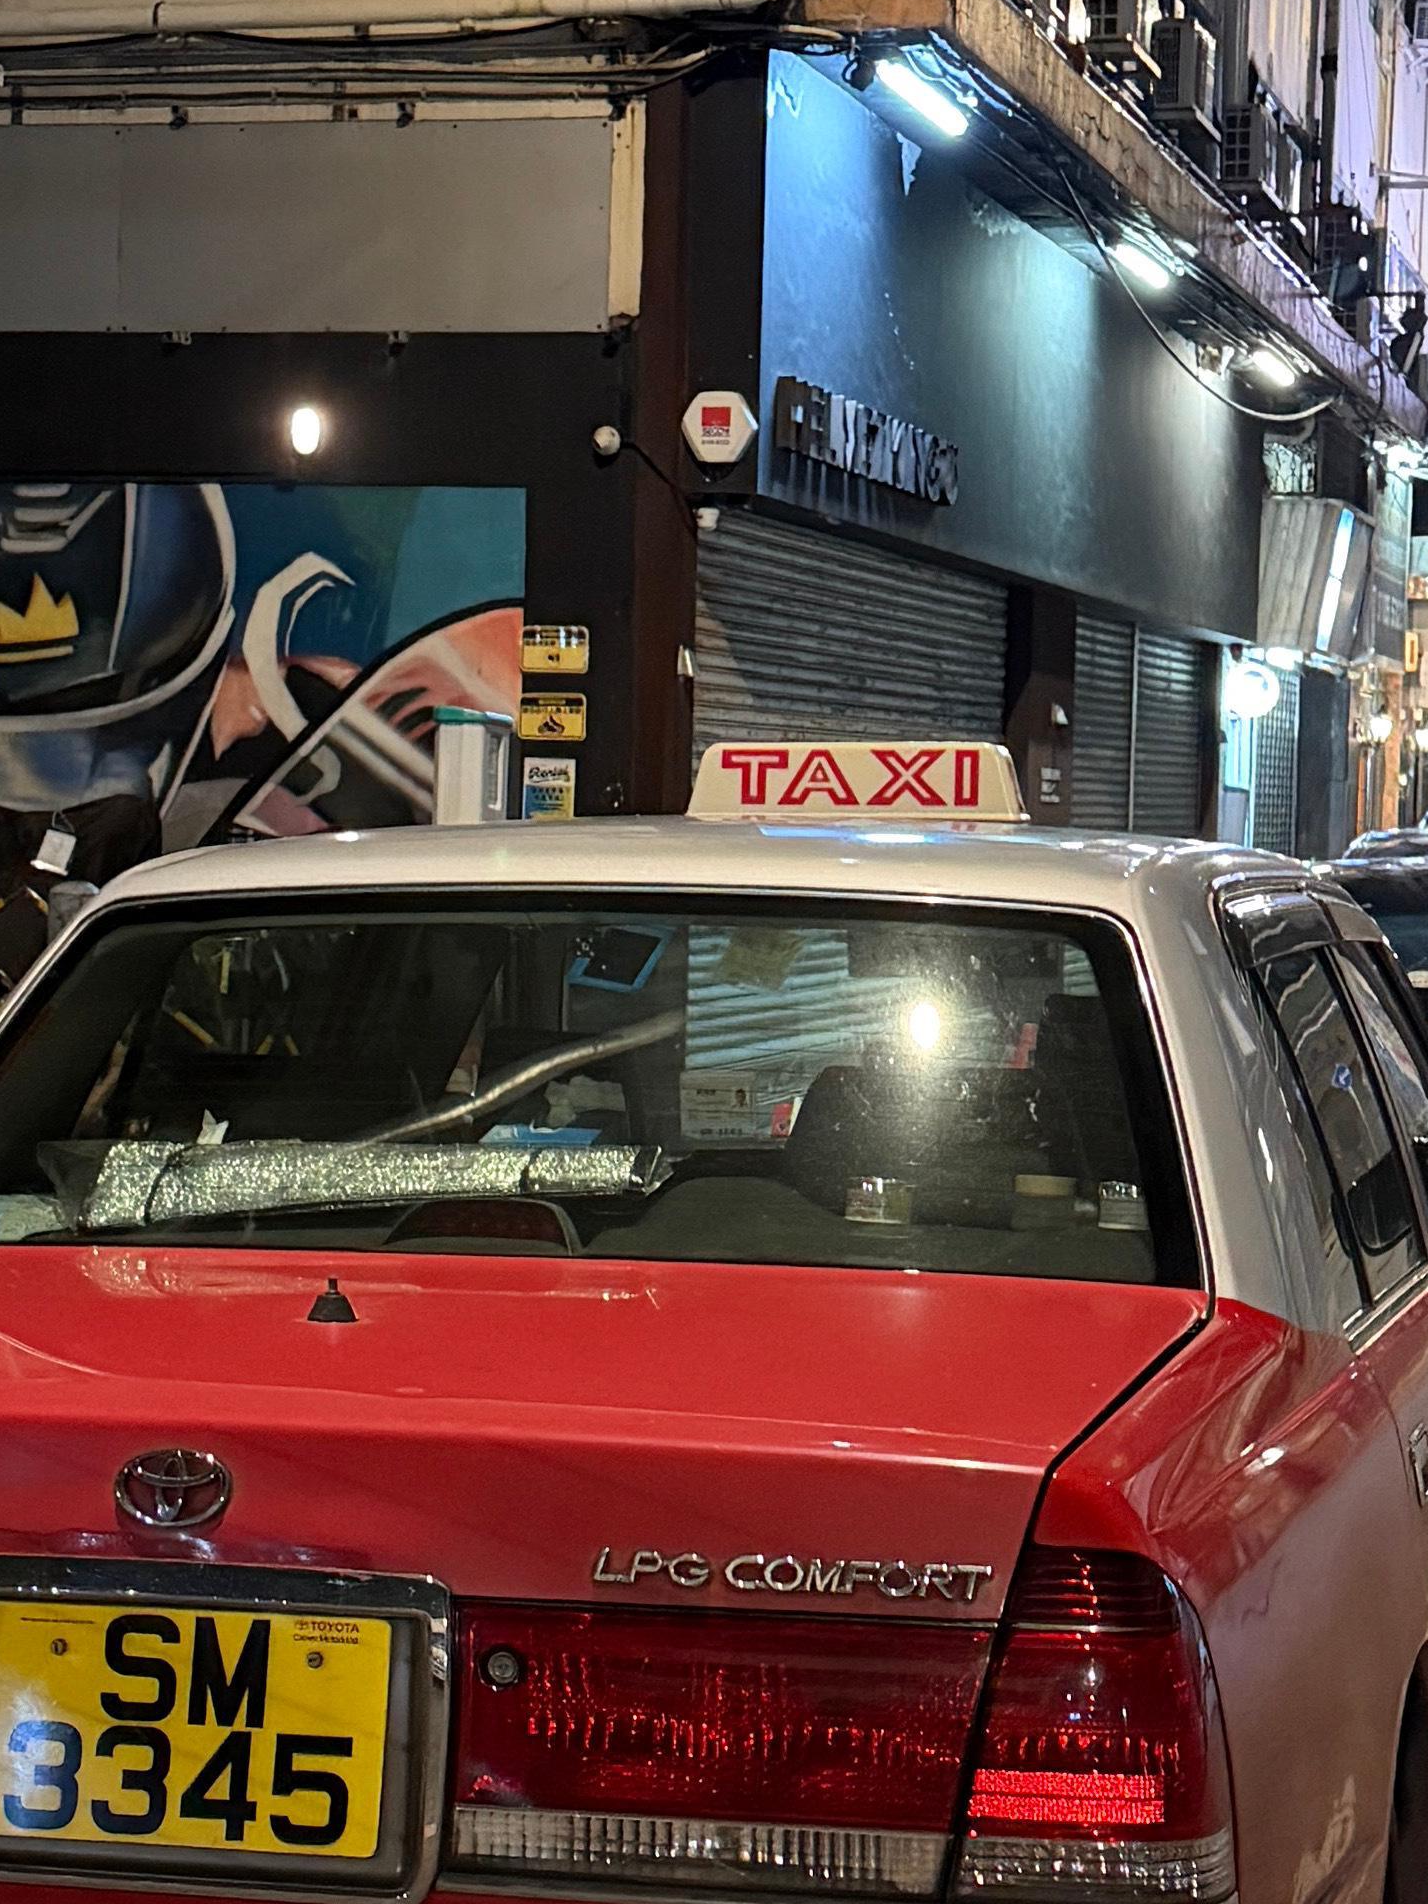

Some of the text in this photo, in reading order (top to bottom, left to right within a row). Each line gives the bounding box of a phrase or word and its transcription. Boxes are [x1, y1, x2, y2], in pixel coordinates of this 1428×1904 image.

[721, 749, 980, 807] TAXI
[592, 1547, 993, 1600] LPG COMFORT
[311, 1621, 359, 1633] TOYOTA
[100, 1613, 271, 1729] SM
[3, 1720, 354, 1846] 3345
